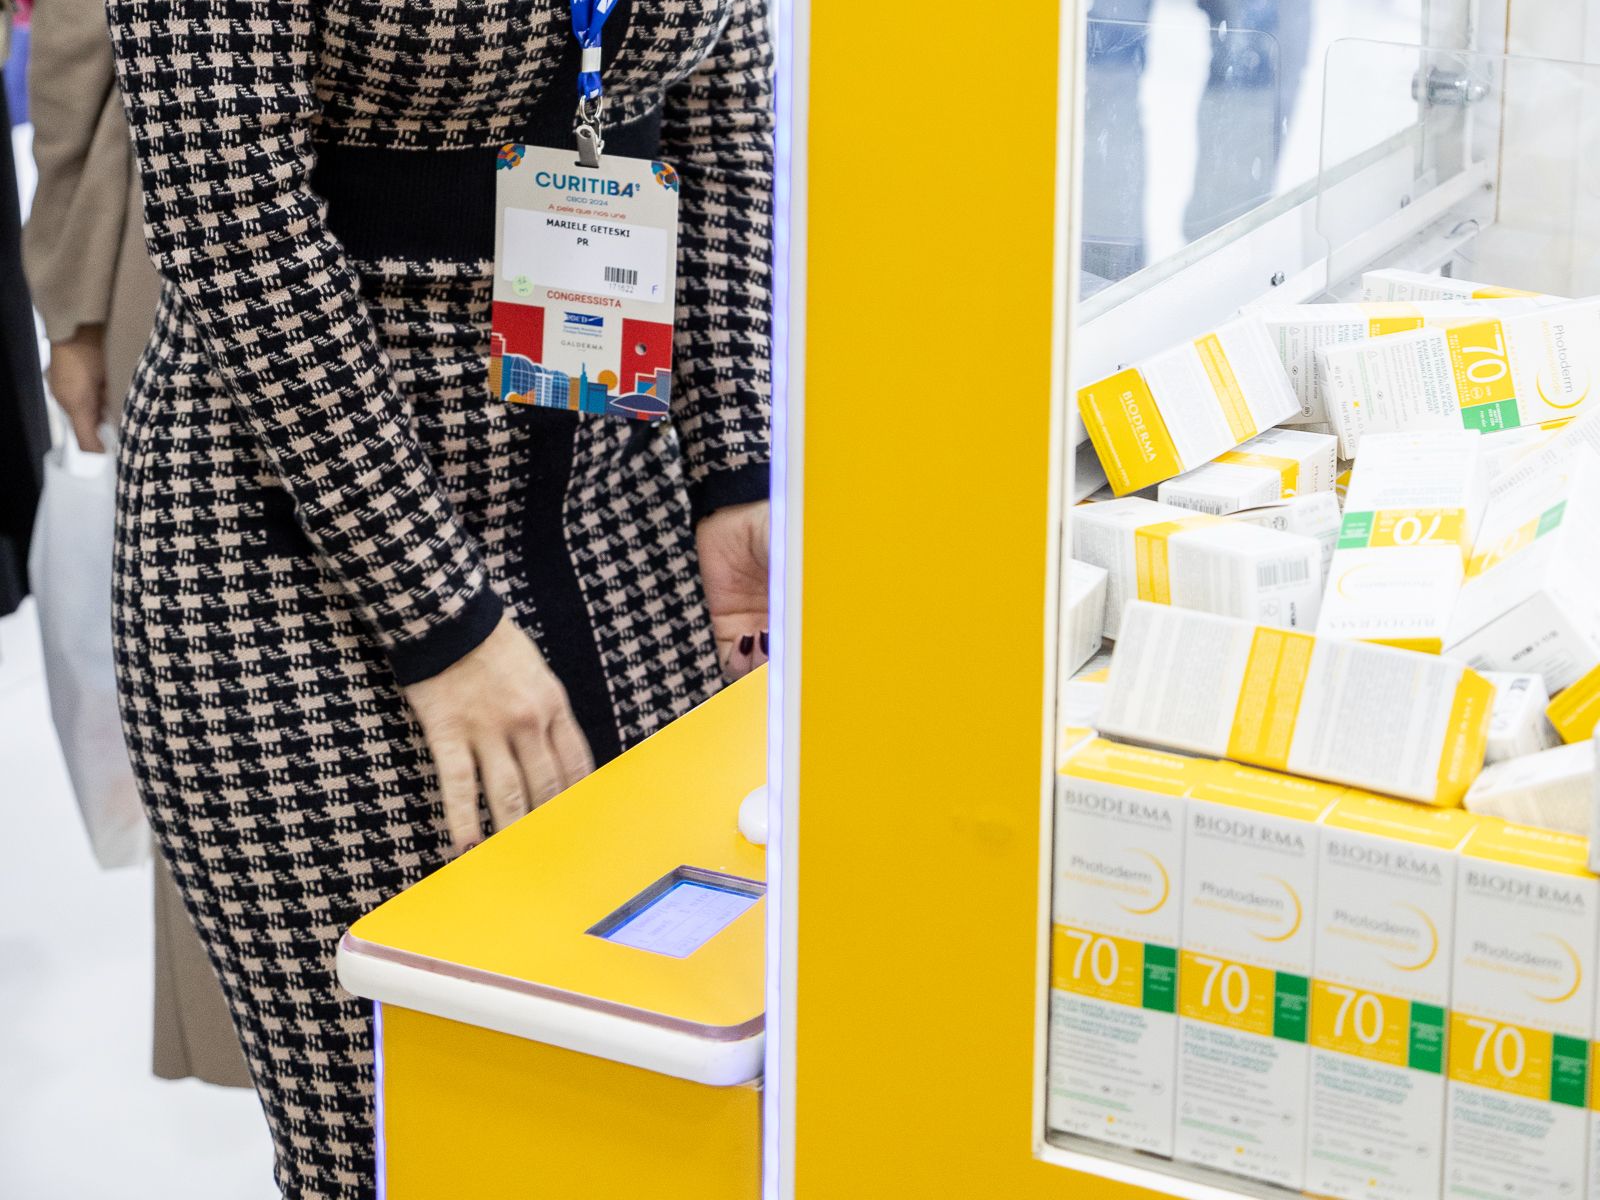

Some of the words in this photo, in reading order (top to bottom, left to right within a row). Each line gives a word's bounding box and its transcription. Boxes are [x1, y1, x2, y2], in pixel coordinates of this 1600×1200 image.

[575, 207, 591, 215] que
[589, 198, 608, 206] 2024
[546, 218, 587, 232] MARIELE
[590, 224, 630, 238] GETESKI
[576, 237, 589, 246] PR
[546, 289, 622, 308] CONGRESSISTA
[560, 339, 604, 351] GALDERMA
[1462, 333, 1507, 384] 70
[1553, 324, 1574, 394] Photoderm
[1123, 390, 1157, 462] BIODERMA
[1393, 515, 1457, 546] 70
[1064, 789, 1172, 825] BIODERMA
[1194, 813, 1306, 849] BIODERMA
[1071, 855, 1152, 883] Photoderm
[1327, 840, 1442, 877] BIODERMA
[1201, 881, 1285, 910] Photoderm
[1465, 870, 1586, 907] BIODERMA
[1333, 908, 1421, 939] Photoderm
[1064, 930, 1119, 987] 70
[1472, 940, 1564, 971] Photoderm
[1194, 956, 1250, 1015] 70
[1327, 986, 1385, 1045] 70
[1464, 1018, 1526, 1079] 70
